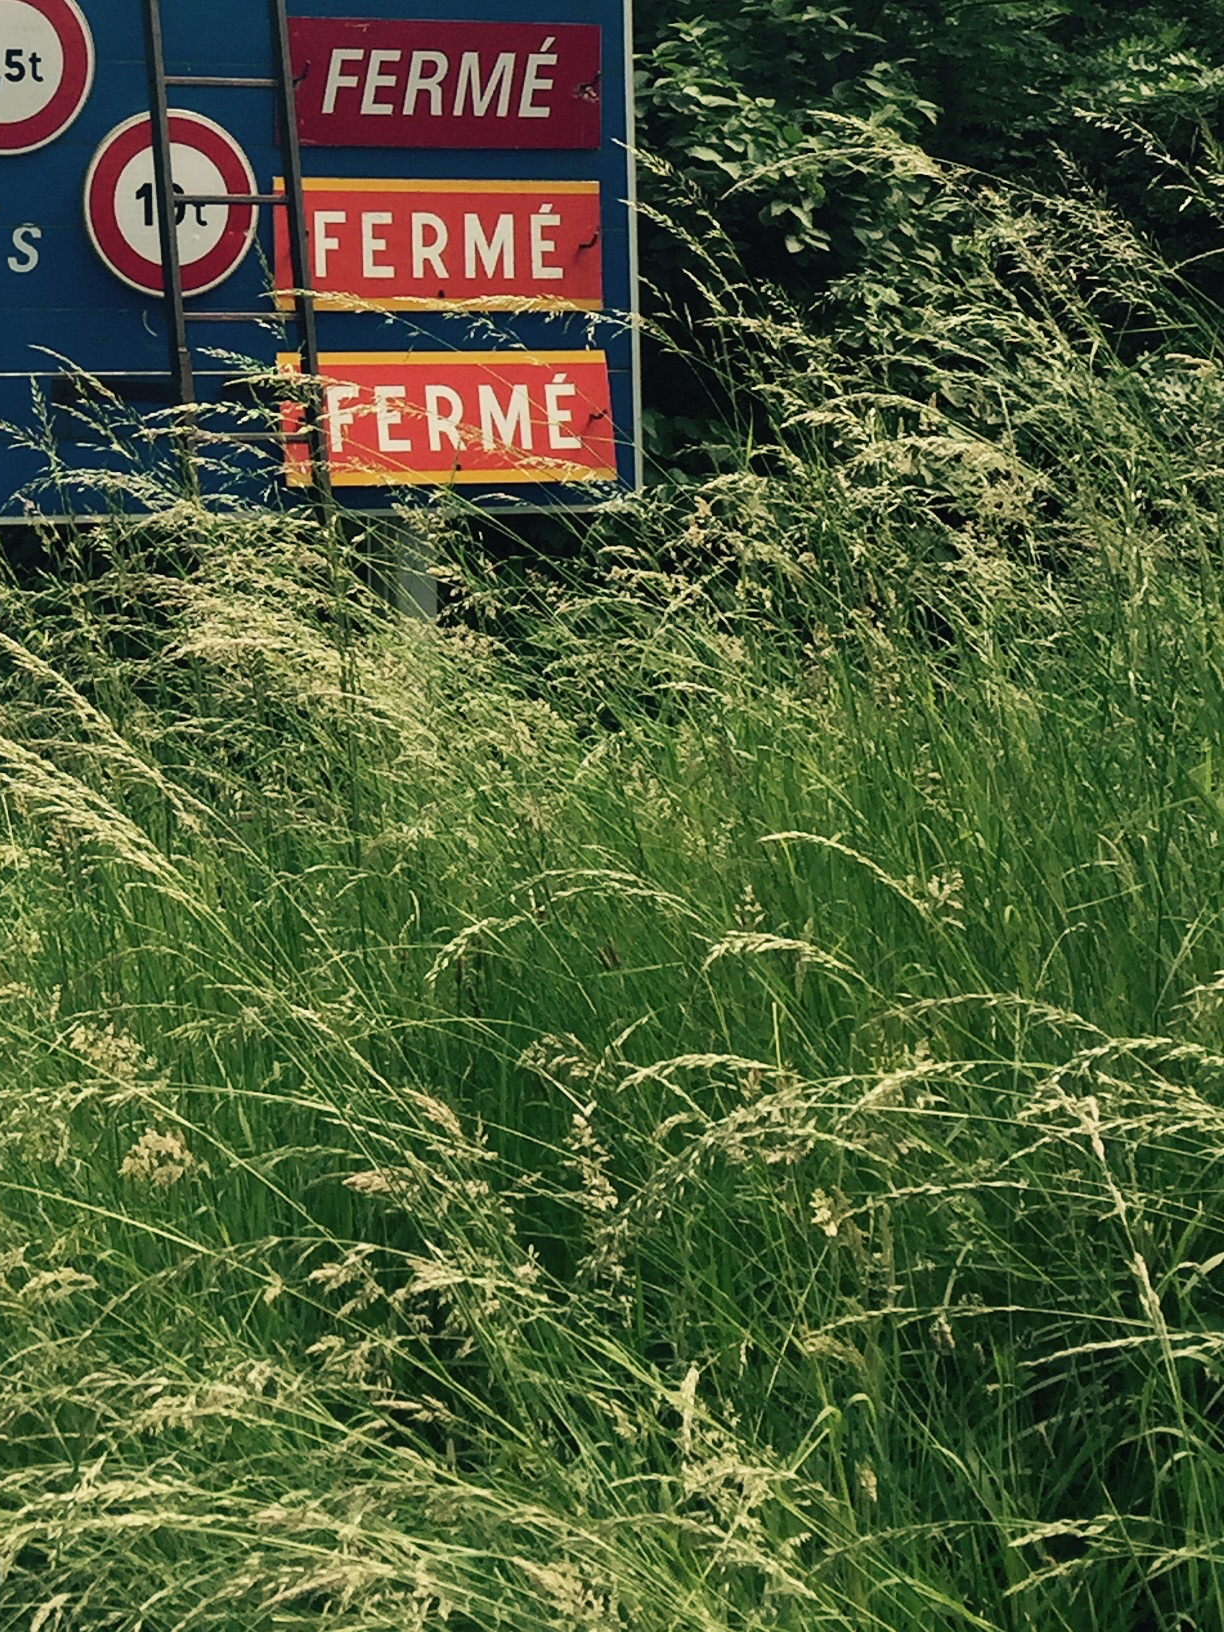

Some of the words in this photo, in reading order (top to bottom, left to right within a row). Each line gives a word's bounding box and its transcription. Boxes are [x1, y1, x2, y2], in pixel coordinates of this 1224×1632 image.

[322, 37, 557, 117] FERMÉ
[314, 204, 563, 279] FERMÉ
[327, 373, 582, 453] FERMÉ
